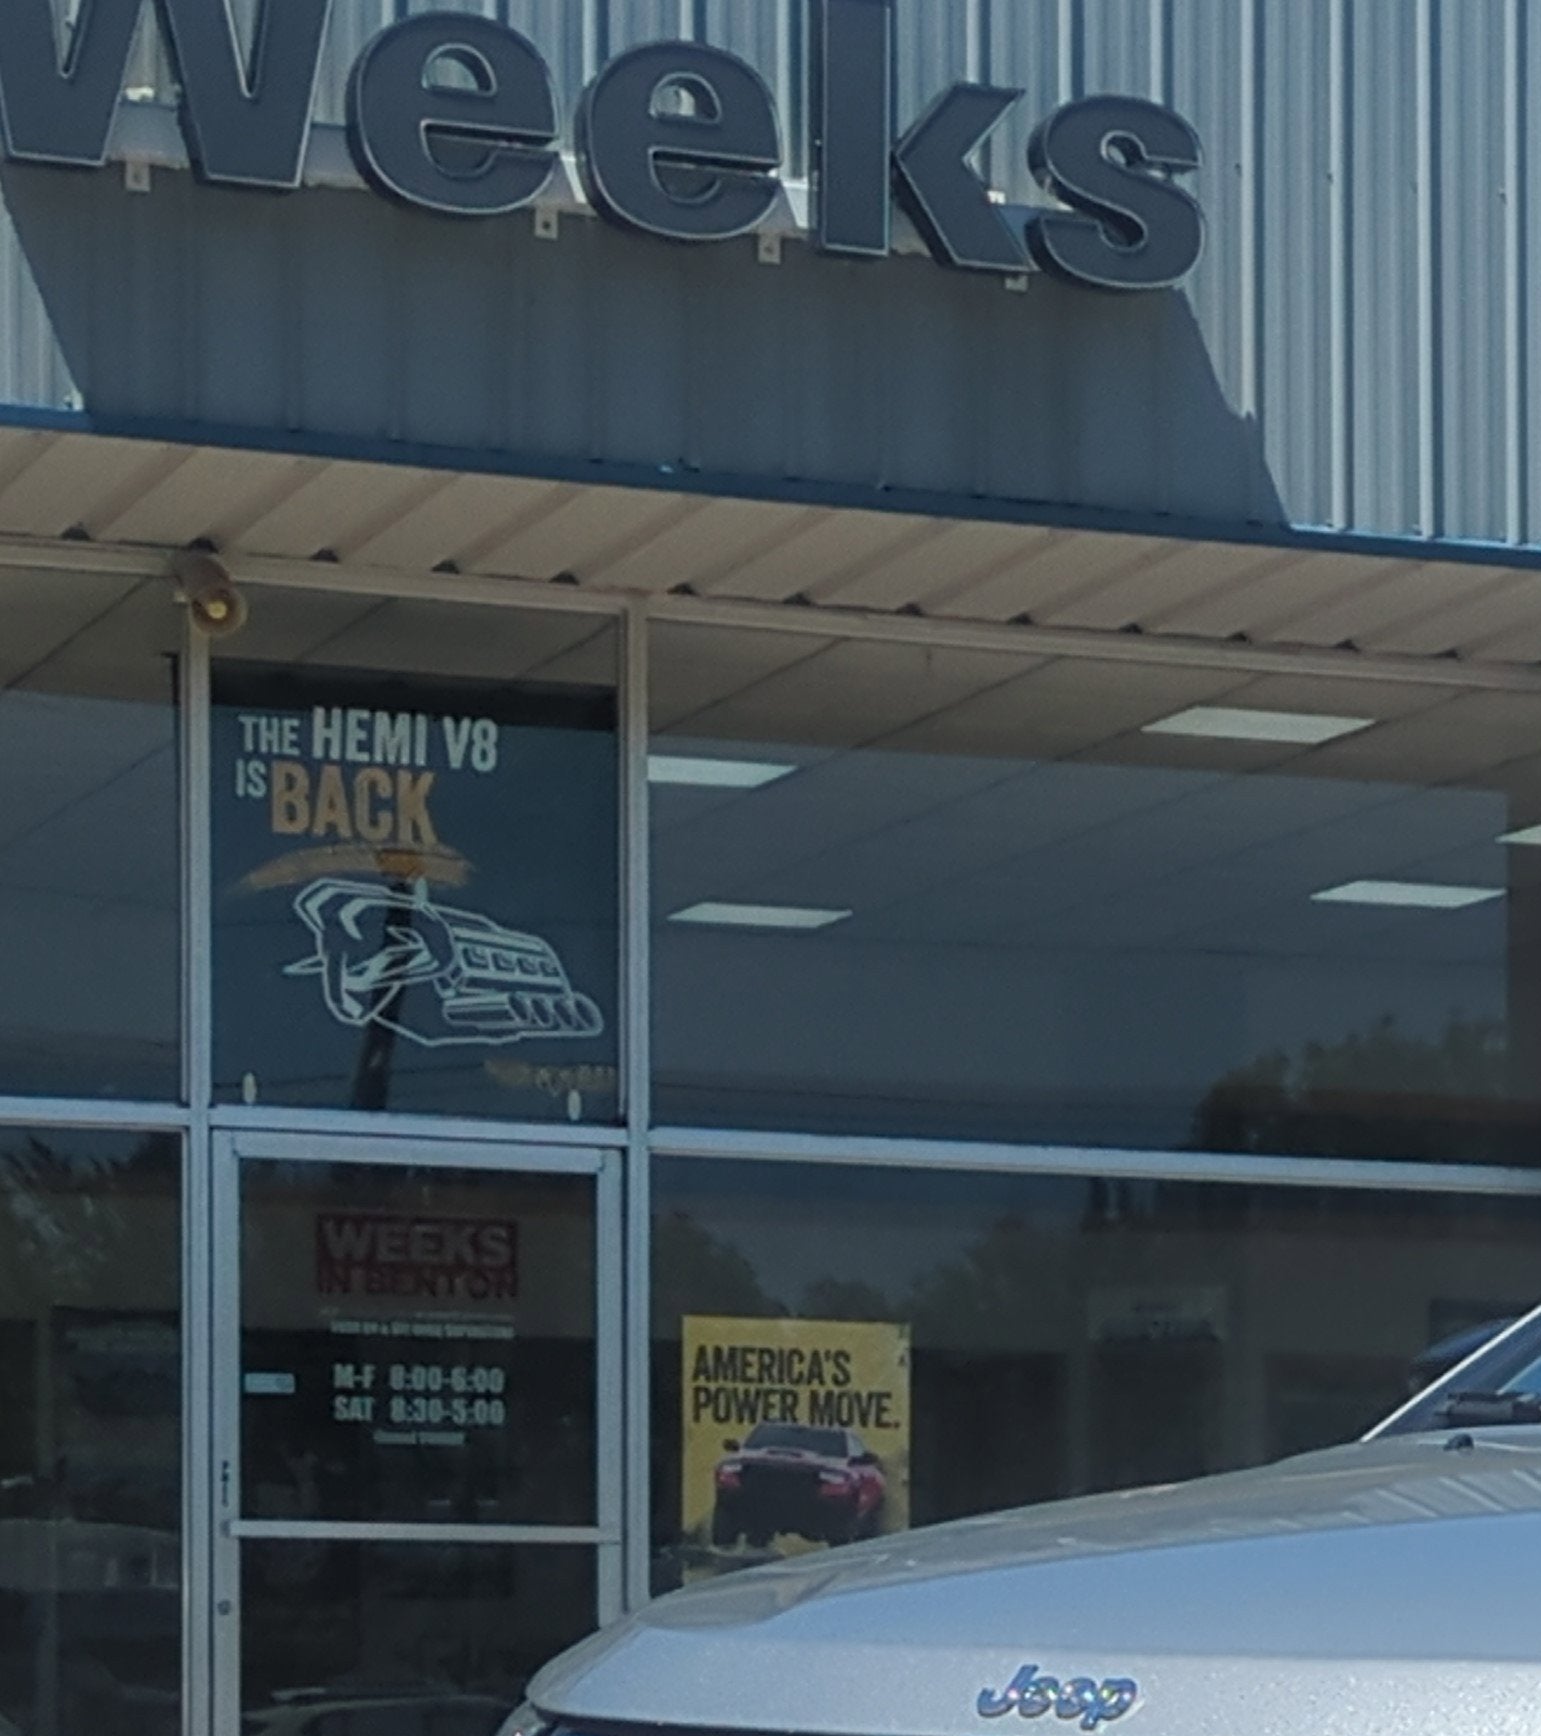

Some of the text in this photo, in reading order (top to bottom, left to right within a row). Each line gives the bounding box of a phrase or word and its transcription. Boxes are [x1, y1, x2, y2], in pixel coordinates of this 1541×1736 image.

[0, 0, 1204, 292] Weeks
[238, 706, 498, 772] THE HEMI V8
[235, 758, 438, 846] IS BACK
[321, 1218, 513, 1267] WEEKS
[332, 1363, 376, 1389] M-F
[692, 1344, 851, 1387] AMERICA'S
[333, 1395, 506, 1426] SAT 8:30-5:00
[692, 1386, 901, 1429] POWER MOVE.
[977, 1664, 1138, 1730] Jeep
